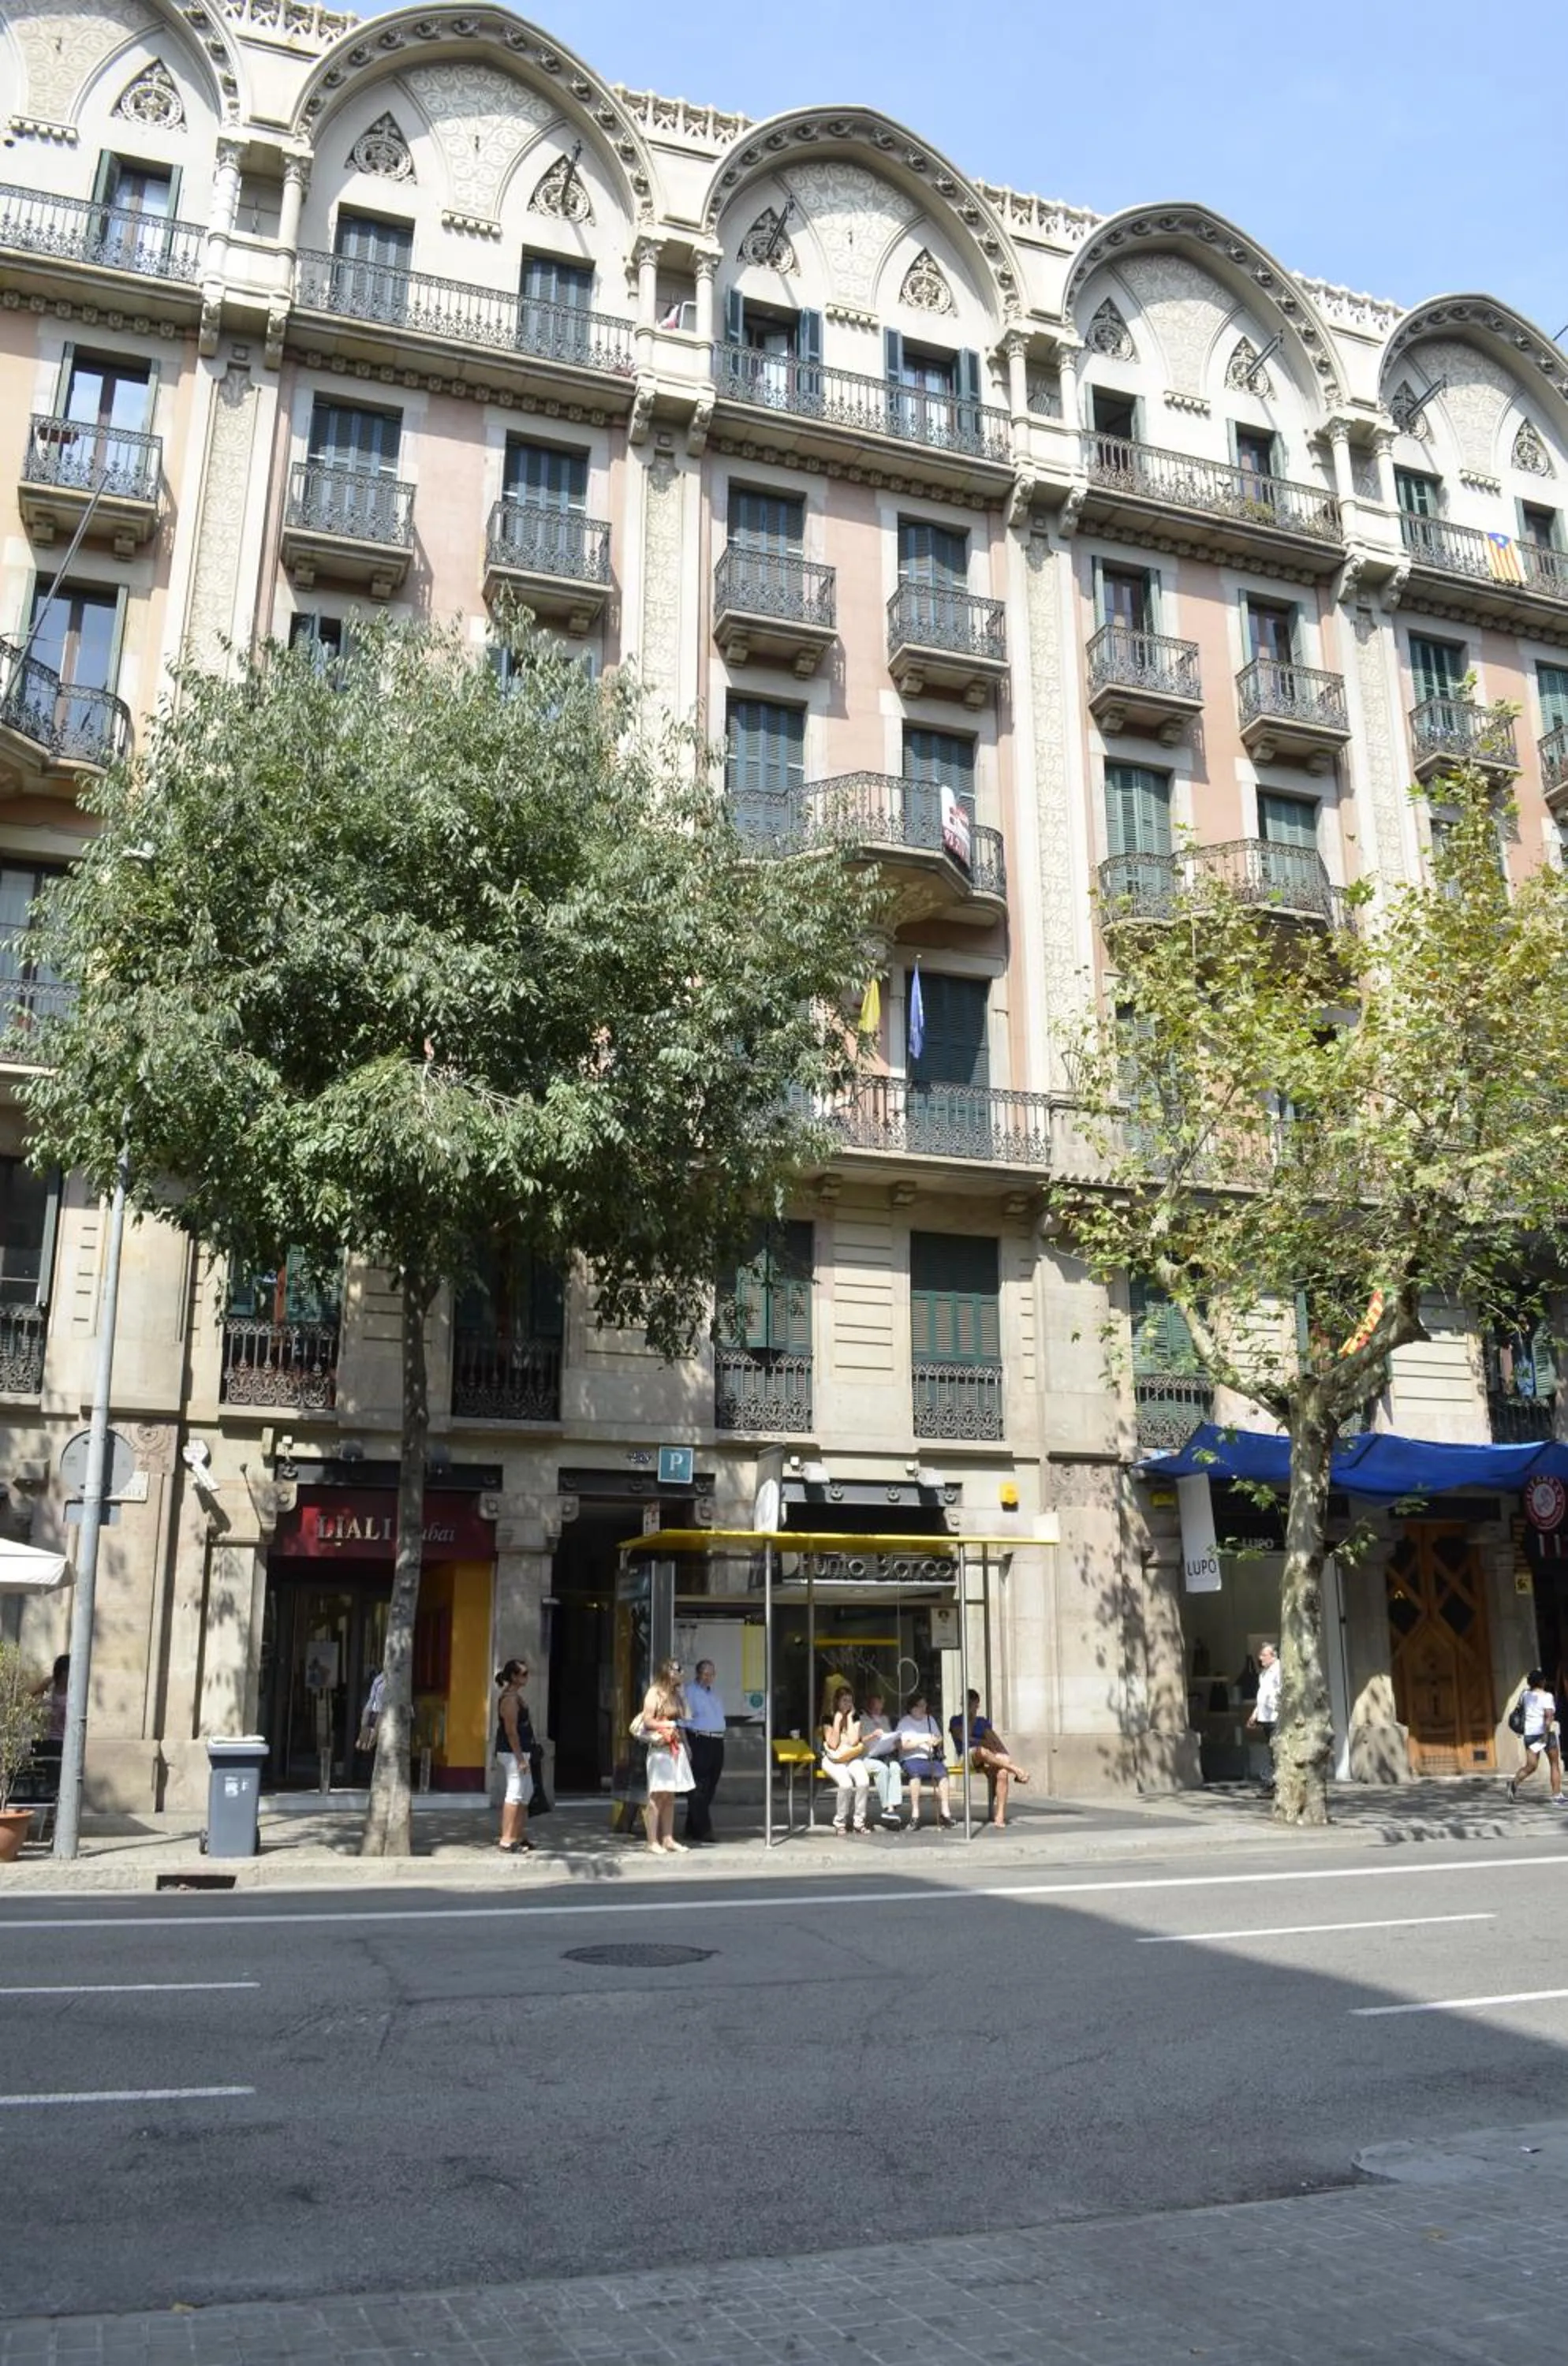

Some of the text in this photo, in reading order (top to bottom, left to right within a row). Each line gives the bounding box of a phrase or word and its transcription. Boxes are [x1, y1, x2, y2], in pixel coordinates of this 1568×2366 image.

[669, 1452, 683, 1471] P
[317, 1515, 456, 1543] LIALI ubai
[1242, 1538, 1274, 1550] LUPO
[1186, 1558, 1217, 1577] LUPO
